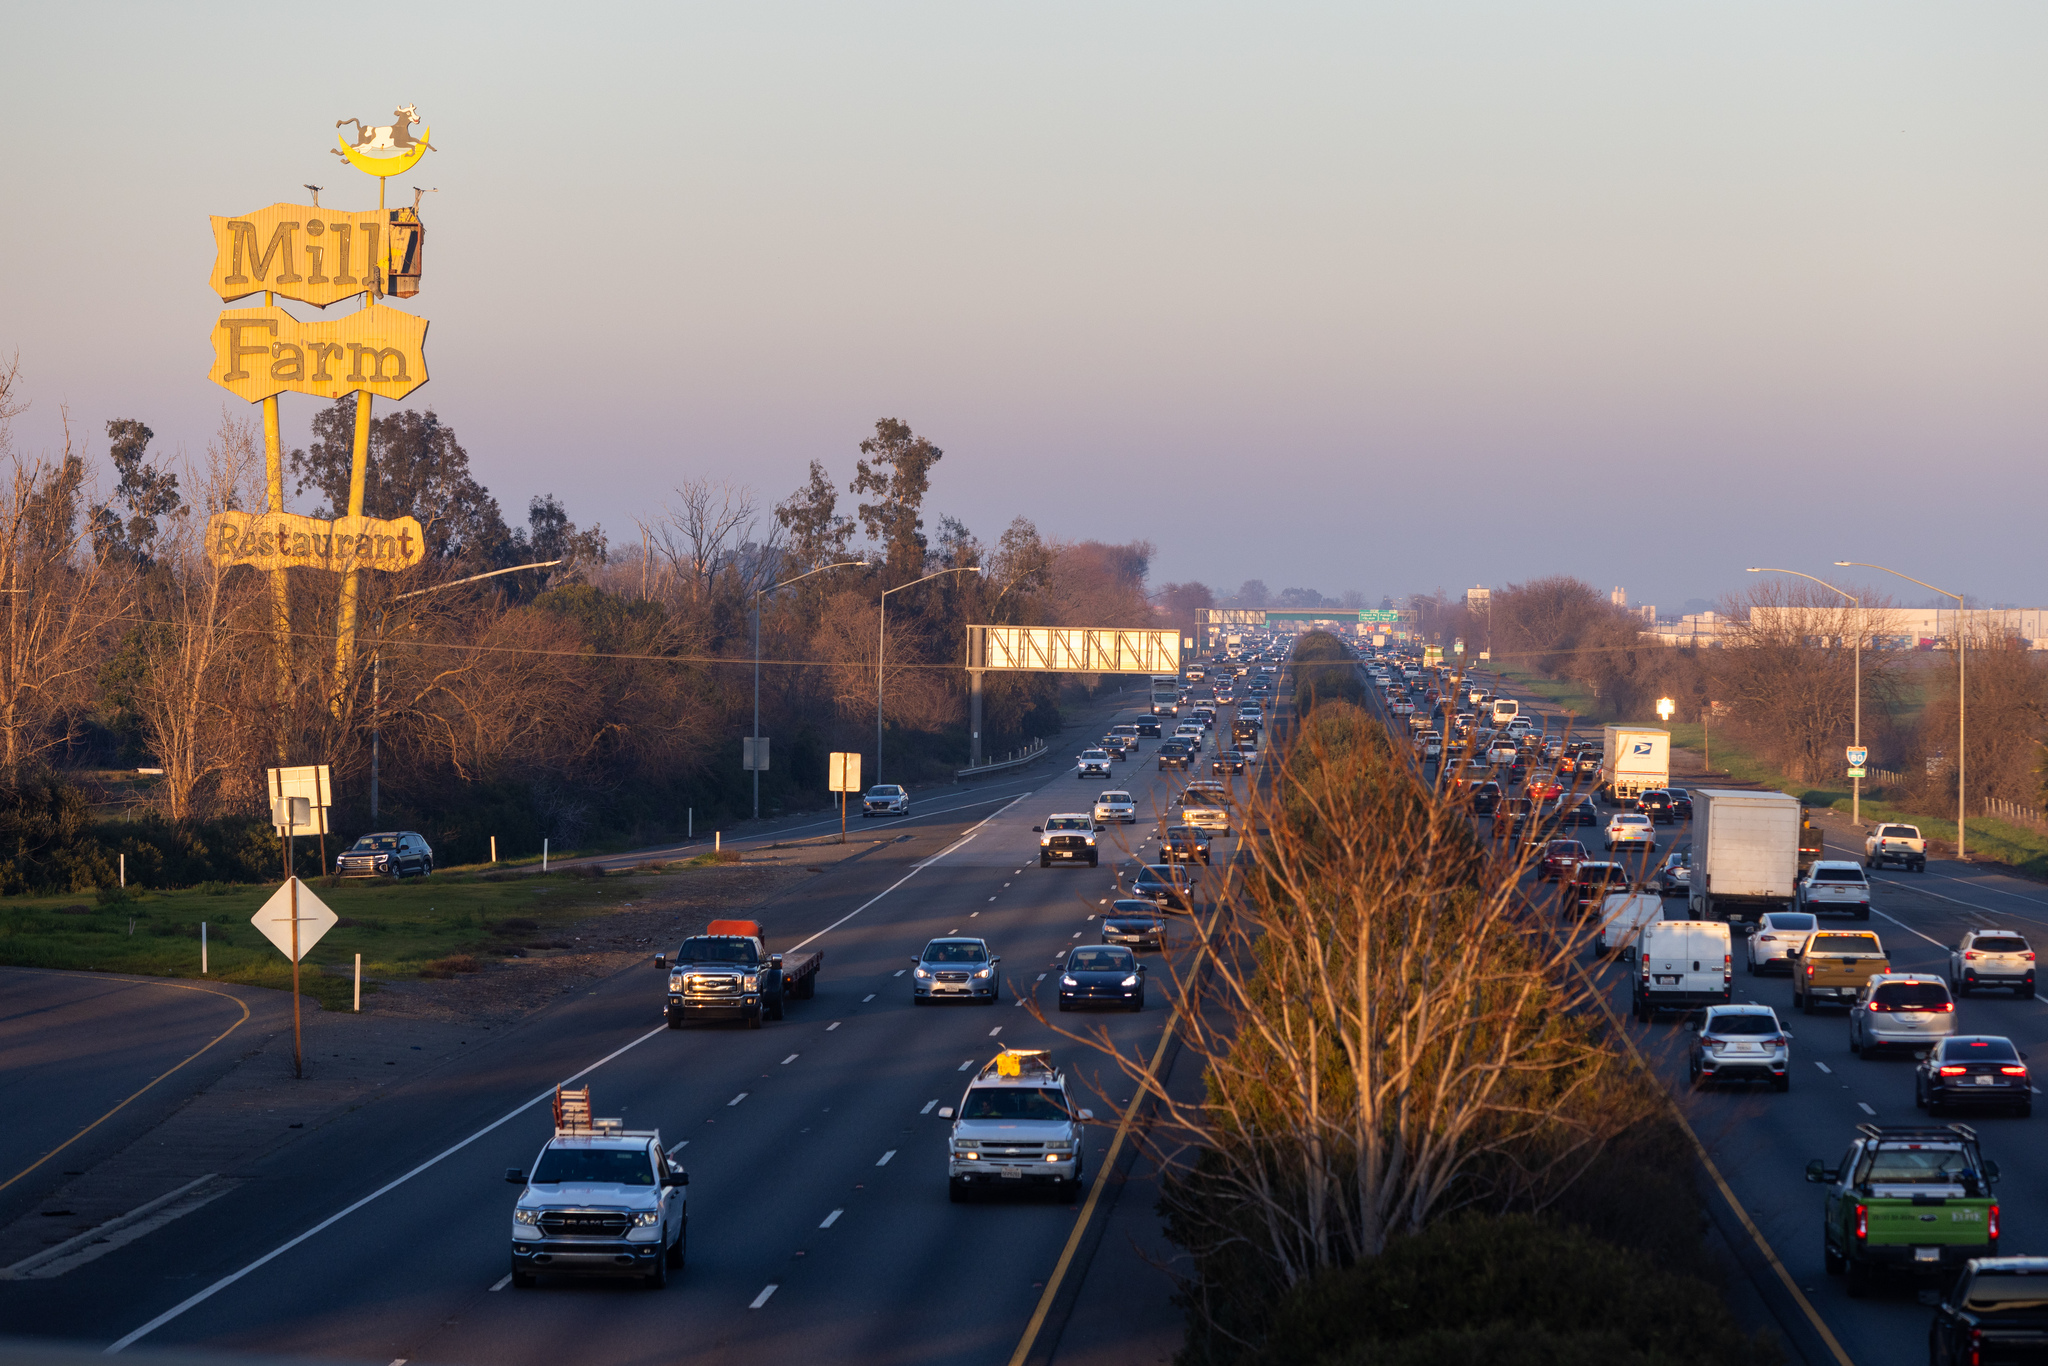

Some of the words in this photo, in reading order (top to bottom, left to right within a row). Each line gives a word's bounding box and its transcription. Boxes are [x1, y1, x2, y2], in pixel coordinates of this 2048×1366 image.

[220, 319, 411, 382] Farm
[219, 522, 414, 559] Restaurant
[1851, 754, 1863, 762] 80
